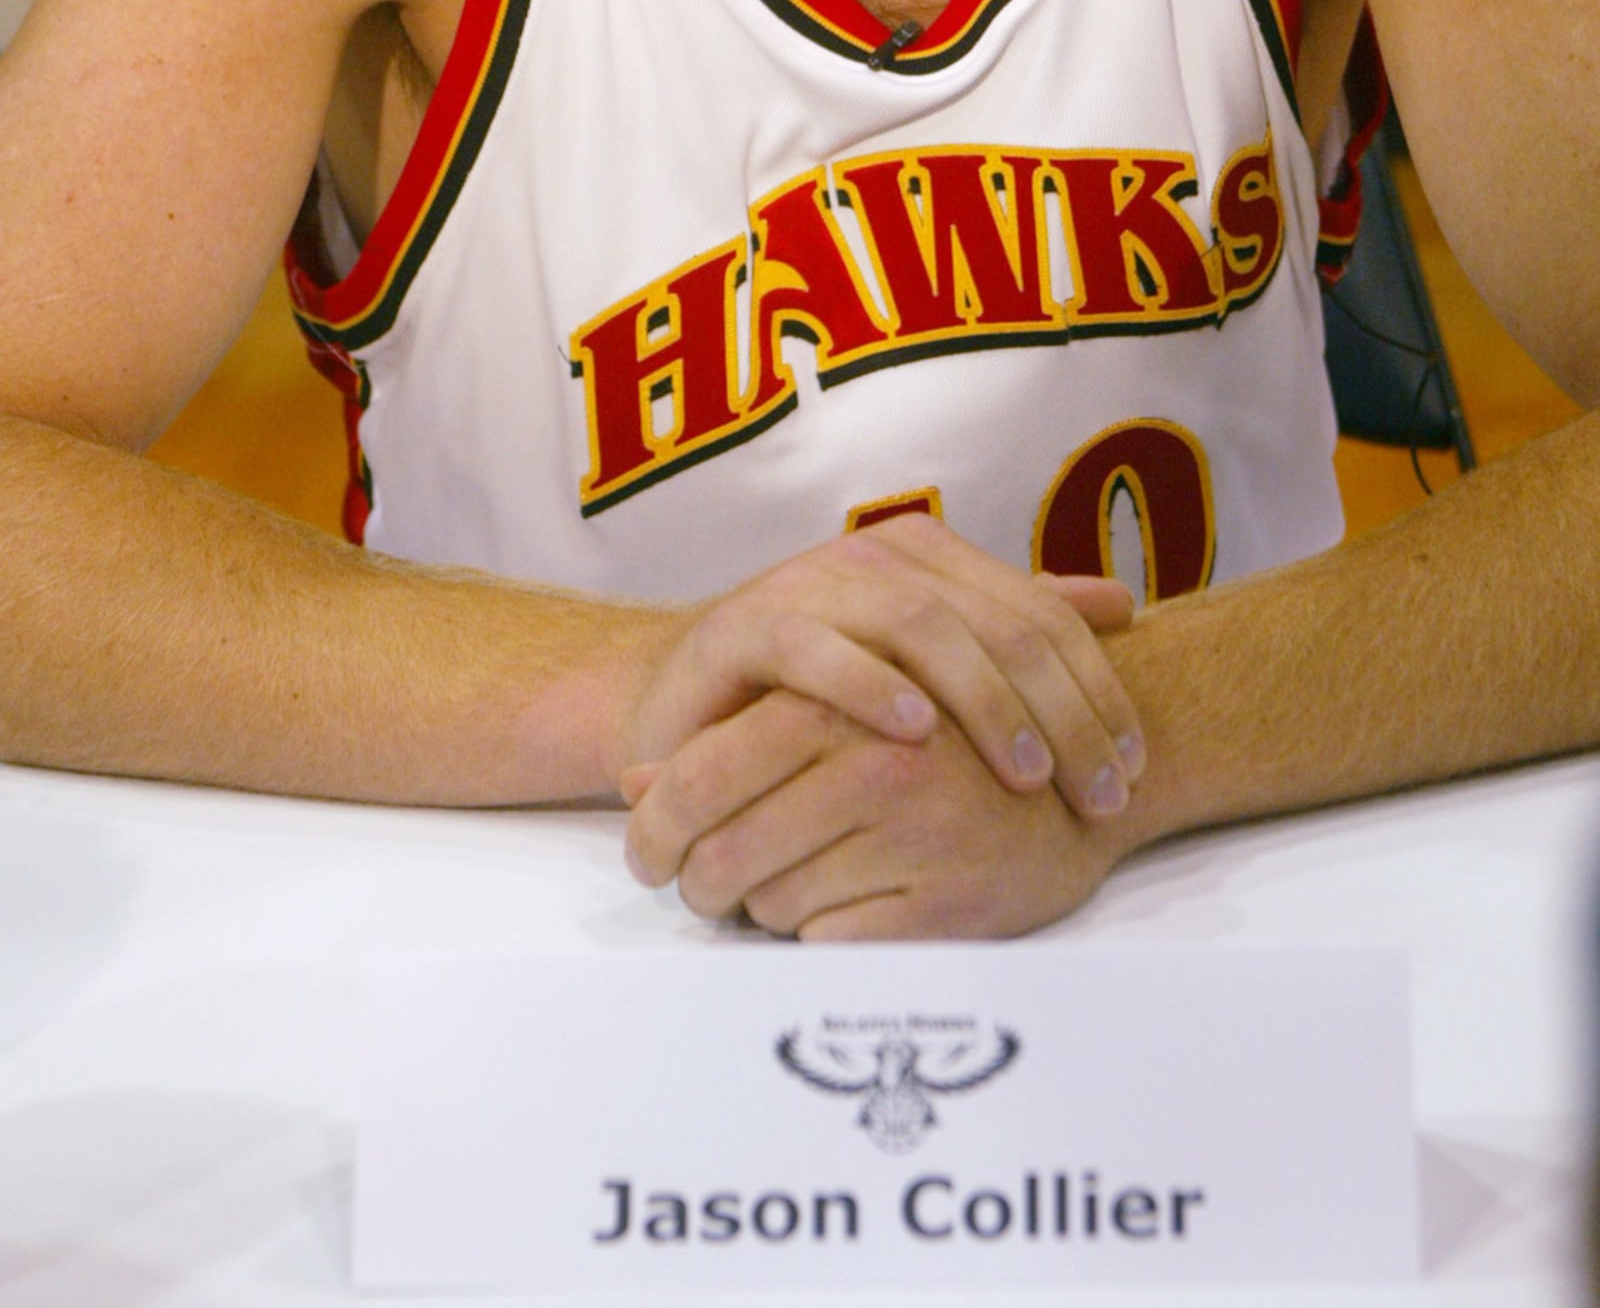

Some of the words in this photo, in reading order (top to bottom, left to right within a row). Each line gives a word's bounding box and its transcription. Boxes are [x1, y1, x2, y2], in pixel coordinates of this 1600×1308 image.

[569, 125, 1286, 518] HAWKS
[844, 417, 1217, 604] 0
[594, 1180, 859, 1243] Jason
[900, 1173, 1204, 1241] Collier
